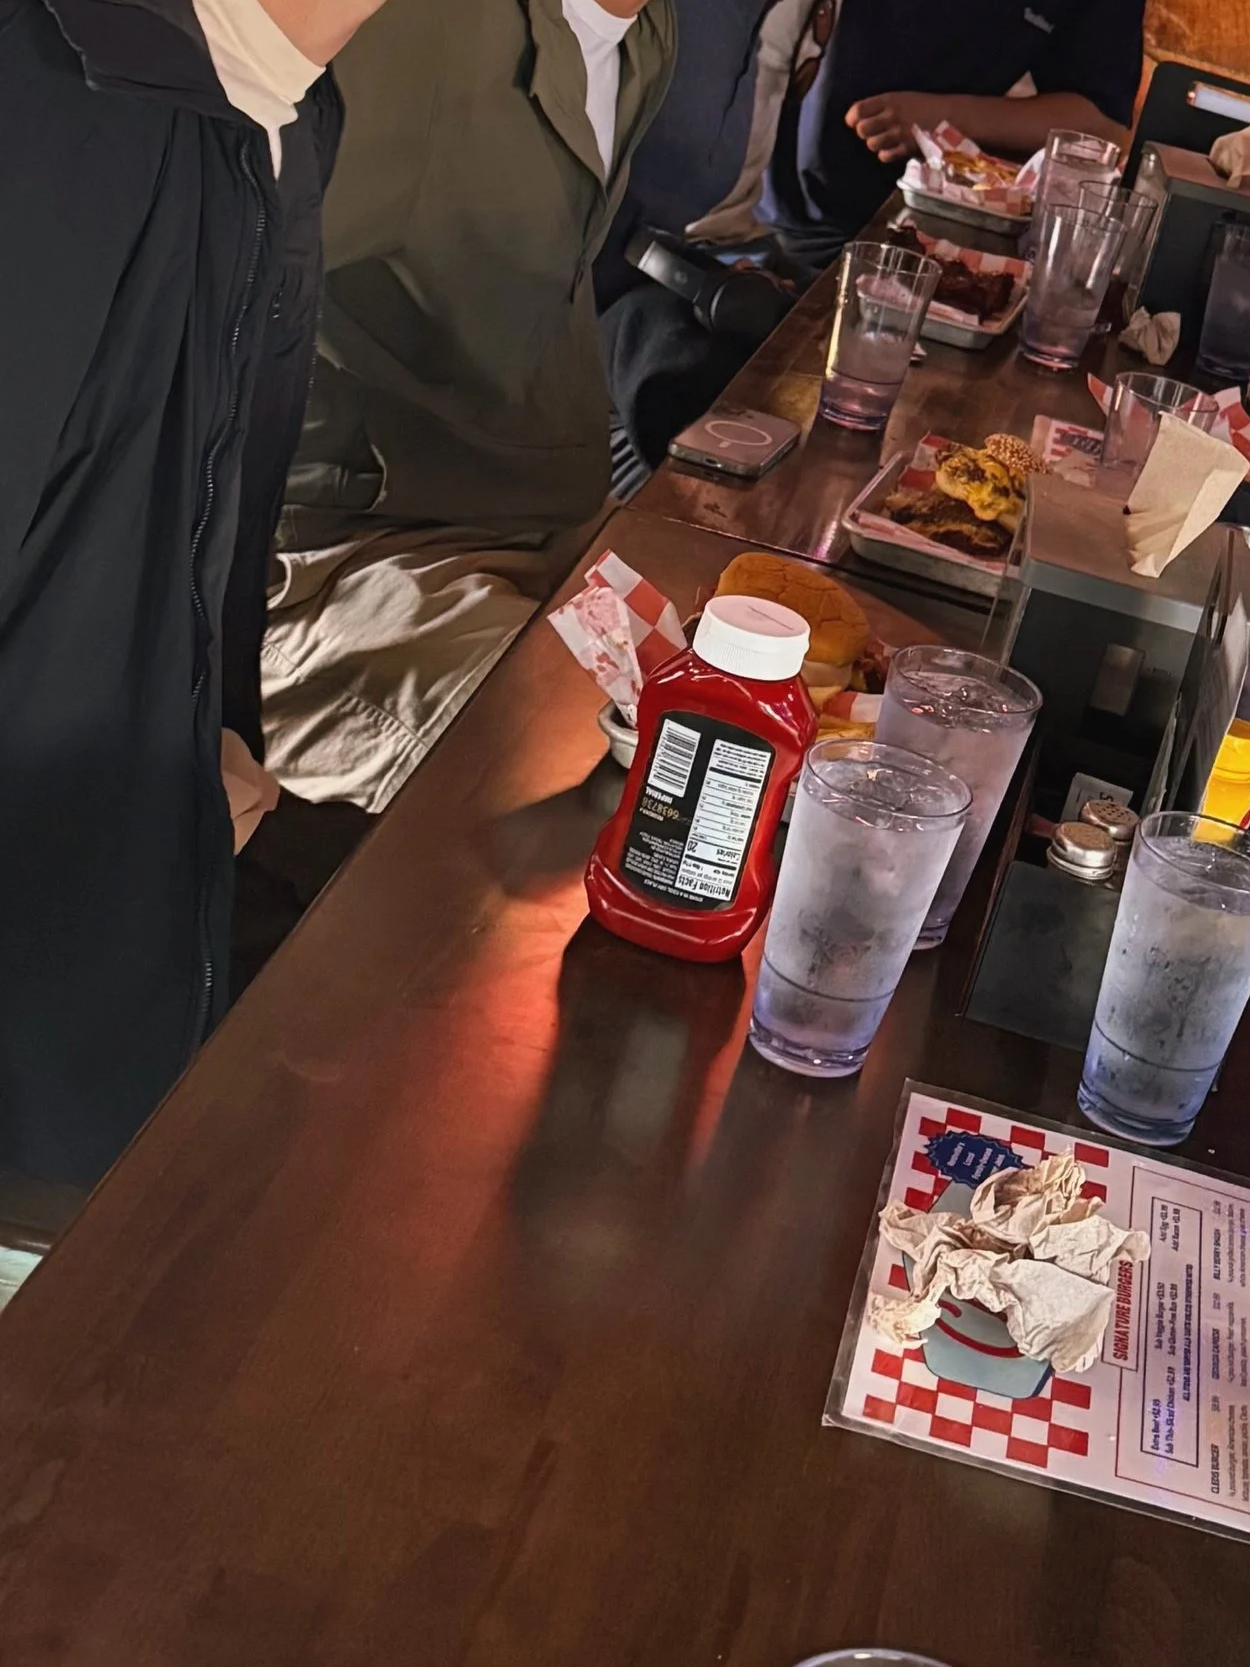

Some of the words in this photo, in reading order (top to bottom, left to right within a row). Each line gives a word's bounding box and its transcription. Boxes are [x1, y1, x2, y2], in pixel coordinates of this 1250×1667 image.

[687, 841, 698, 853] 20
[716, 849, 741, 862] Calories
[678, 876, 698, 891] Facts
[699, 882, 731, 899] Nutrition
[1116, 1260, 1134, 1306] BURGERS
[1113, 1305, 1131, 1362] SIGNATURE
